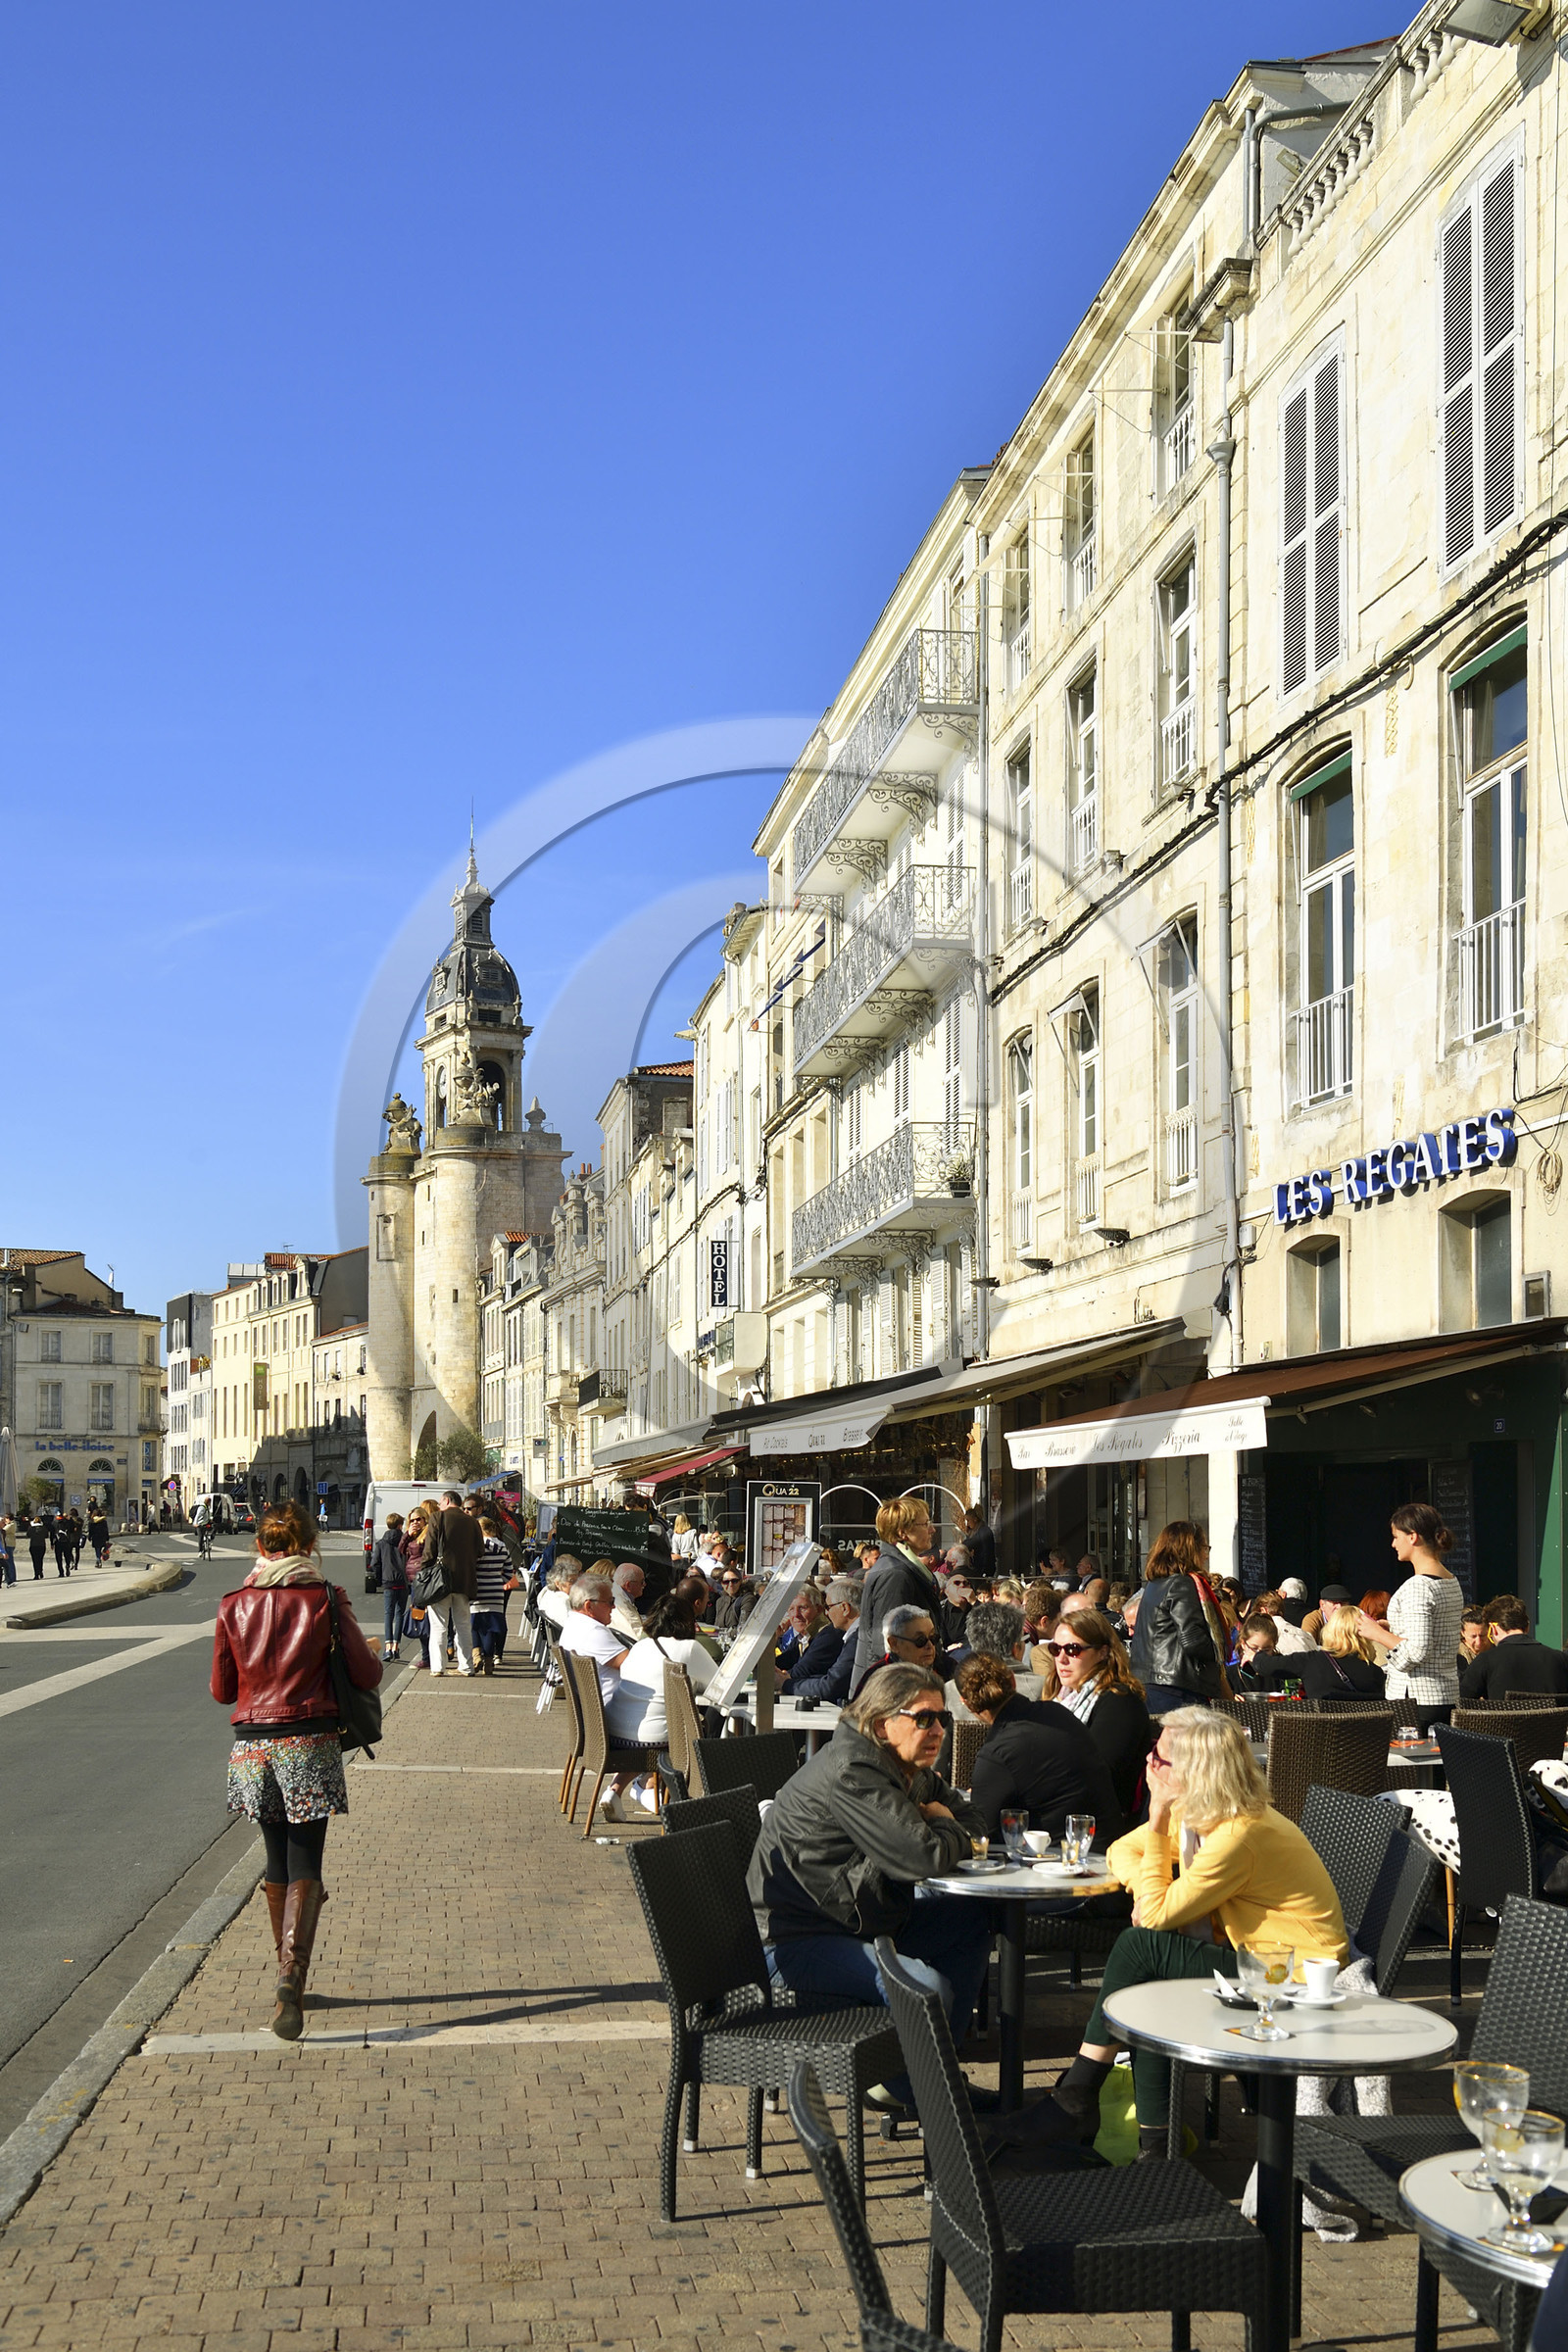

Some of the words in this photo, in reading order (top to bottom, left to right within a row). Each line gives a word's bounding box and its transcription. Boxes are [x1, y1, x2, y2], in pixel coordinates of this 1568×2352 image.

[1271, 1169, 1331, 1226] LES
[1340, 1107, 1516, 1205] REGATES
[712, 1242, 726, 1306] HOTEL
[1495, 1421, 1503, 1430] 20
[35, 1441, 46, 1450] la
[1161, 1428, 1200, 1454] Pizzeria
[788, 1487, 800, 1495] 22
